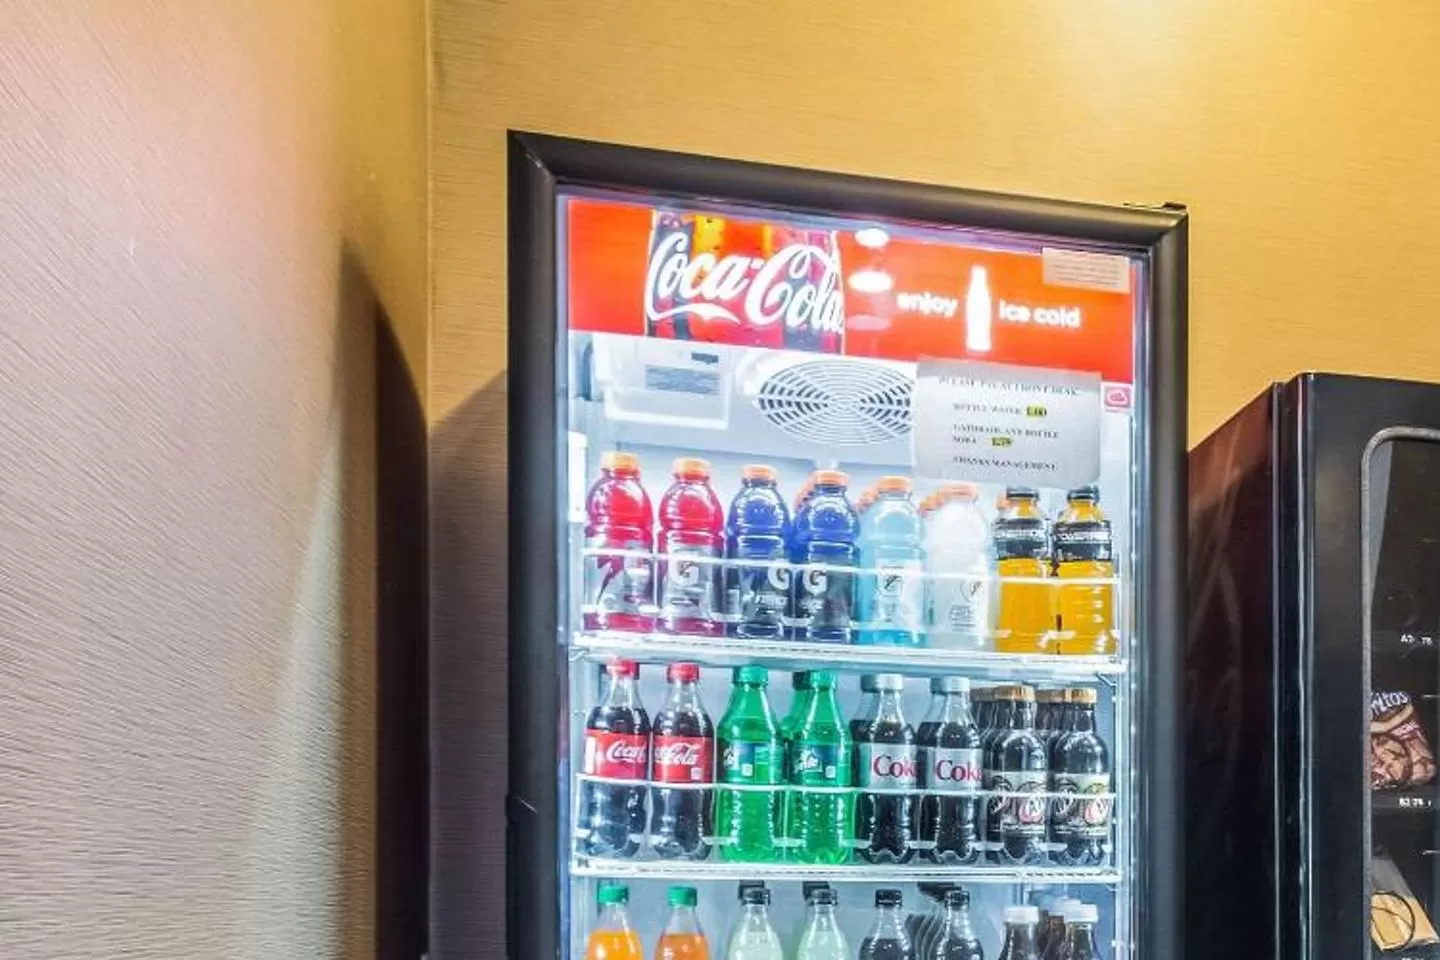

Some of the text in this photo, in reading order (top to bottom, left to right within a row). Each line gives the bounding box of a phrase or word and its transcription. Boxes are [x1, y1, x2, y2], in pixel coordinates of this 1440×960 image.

[645, 232, 844, 335] Coca-Cola
[897, 291, 958, 317] enjoy
[1033, 306, 1081, 328] cold
[873, 754, 917, 778] Cok
